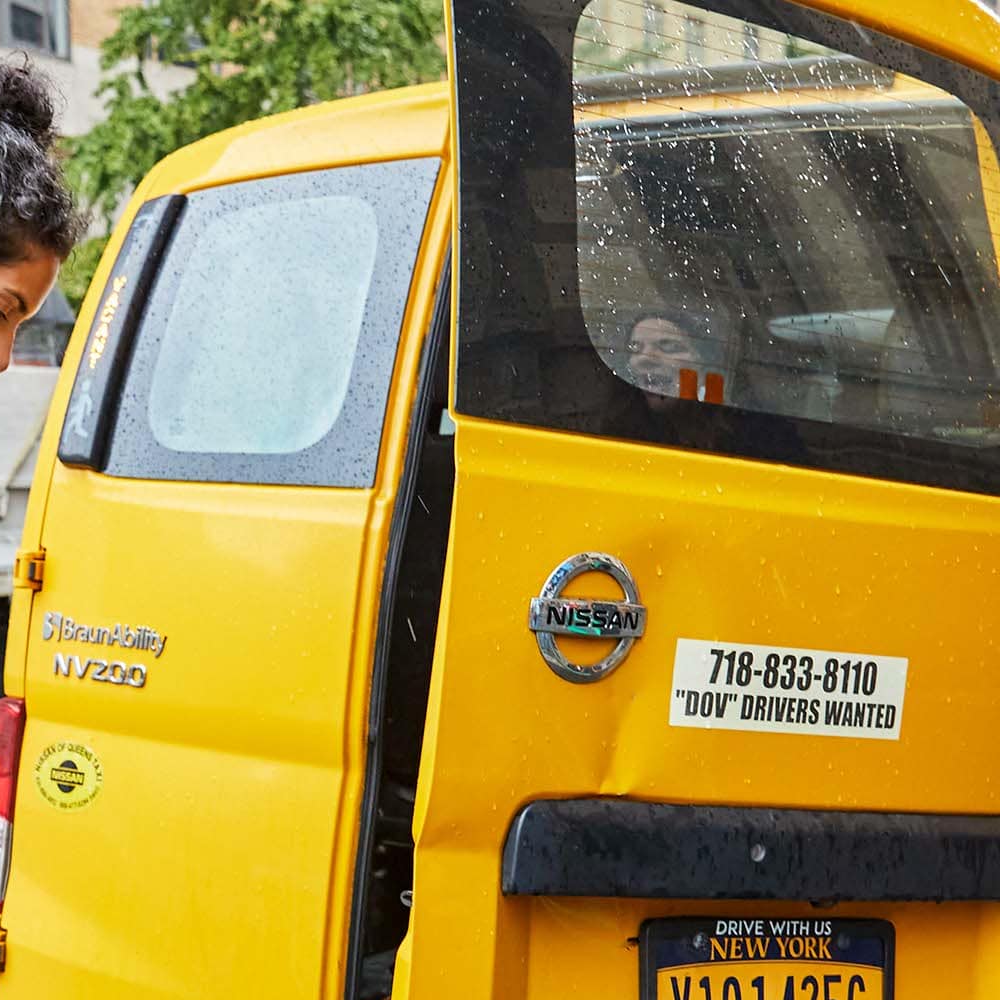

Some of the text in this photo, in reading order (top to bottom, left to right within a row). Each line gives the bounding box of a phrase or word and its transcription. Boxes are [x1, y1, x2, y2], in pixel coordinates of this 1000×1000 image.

[546, 604, 640, 630] NISSAN
[63, 616, 168, 658] BraunAbility
[54, 652, 146, 688] NV200
[708, 648, 878, 696] 718-833-8110
[675, 689, 896, 730] "DOV" DRIVERS WANTED
[715, 920, 832, 936] DRIVE WITH US
[710, 937, 832, 961] NEW YORK
